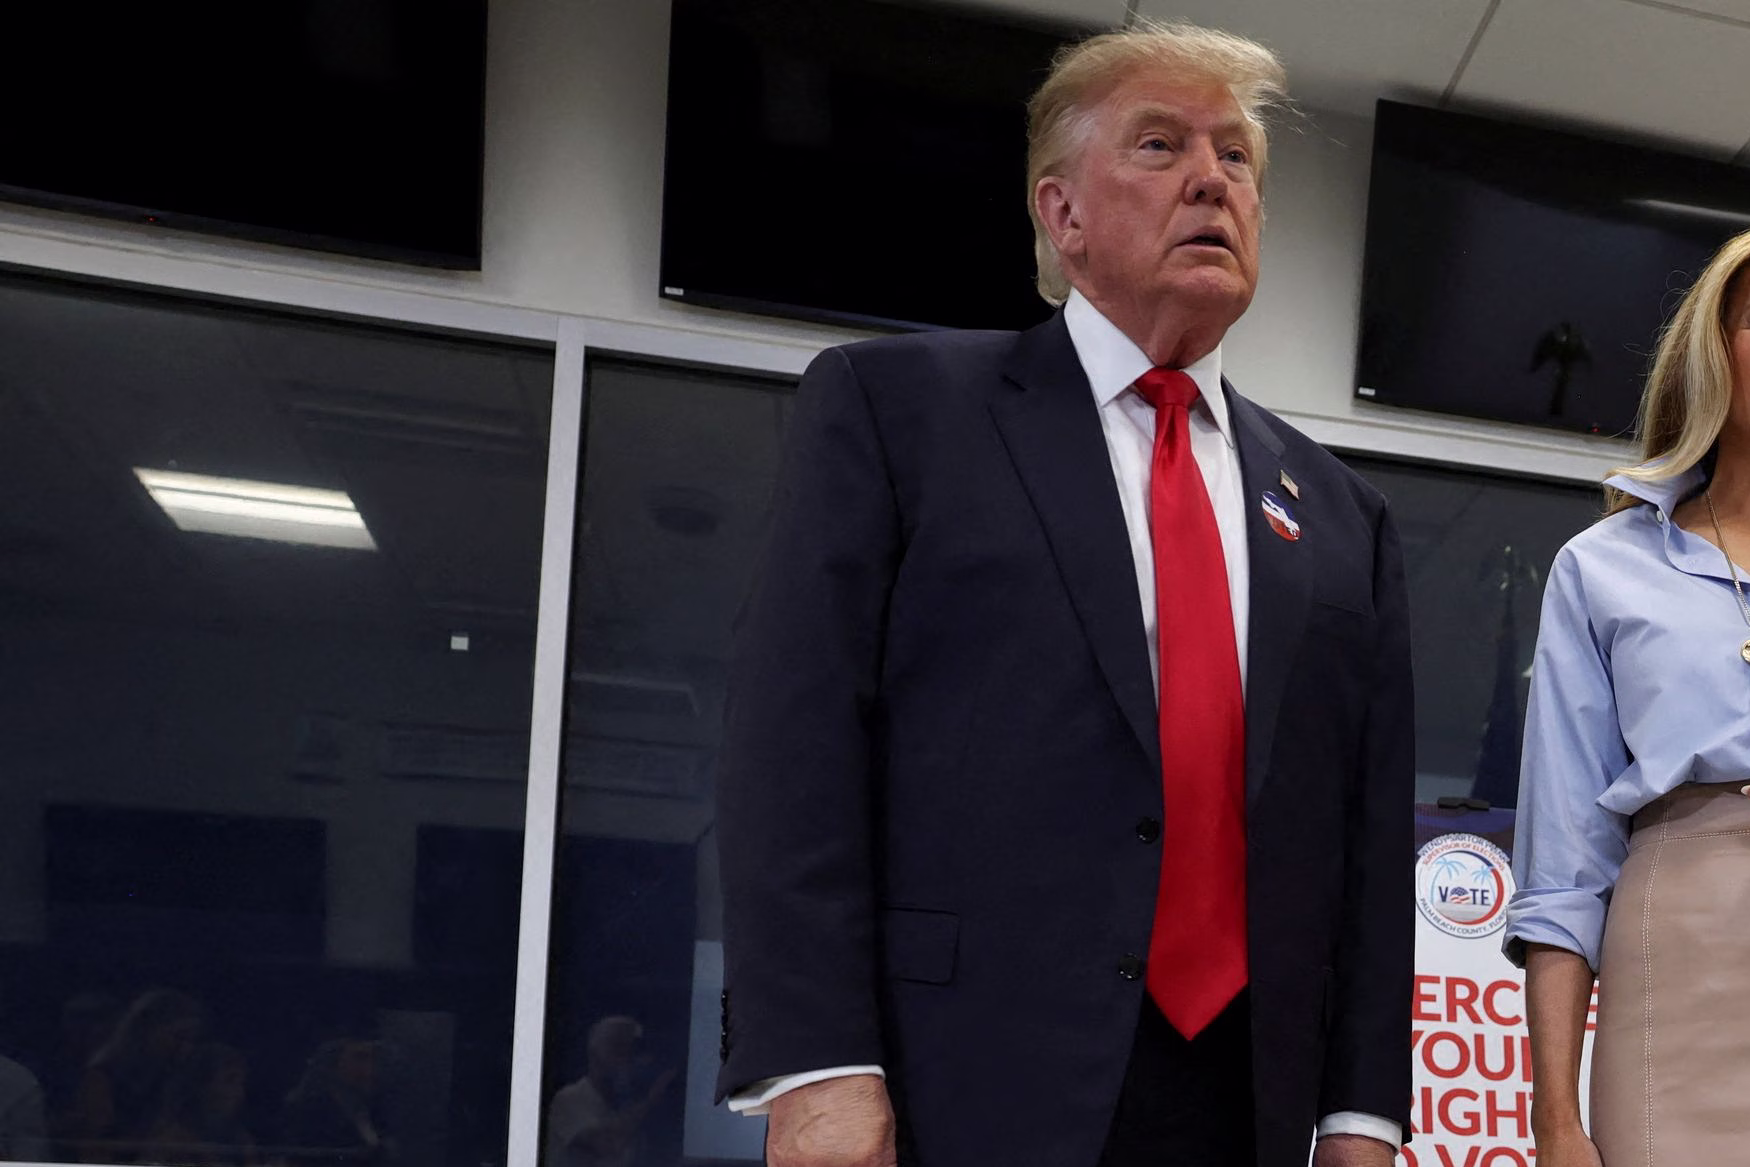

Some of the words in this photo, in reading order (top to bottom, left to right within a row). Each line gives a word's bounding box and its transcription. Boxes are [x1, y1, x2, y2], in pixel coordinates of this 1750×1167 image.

[1438, 886, 1491, 906] VOTE
[1412, 1030, 1533, 1083] OU
[1411, 1086, 1534, 1138] IGH
